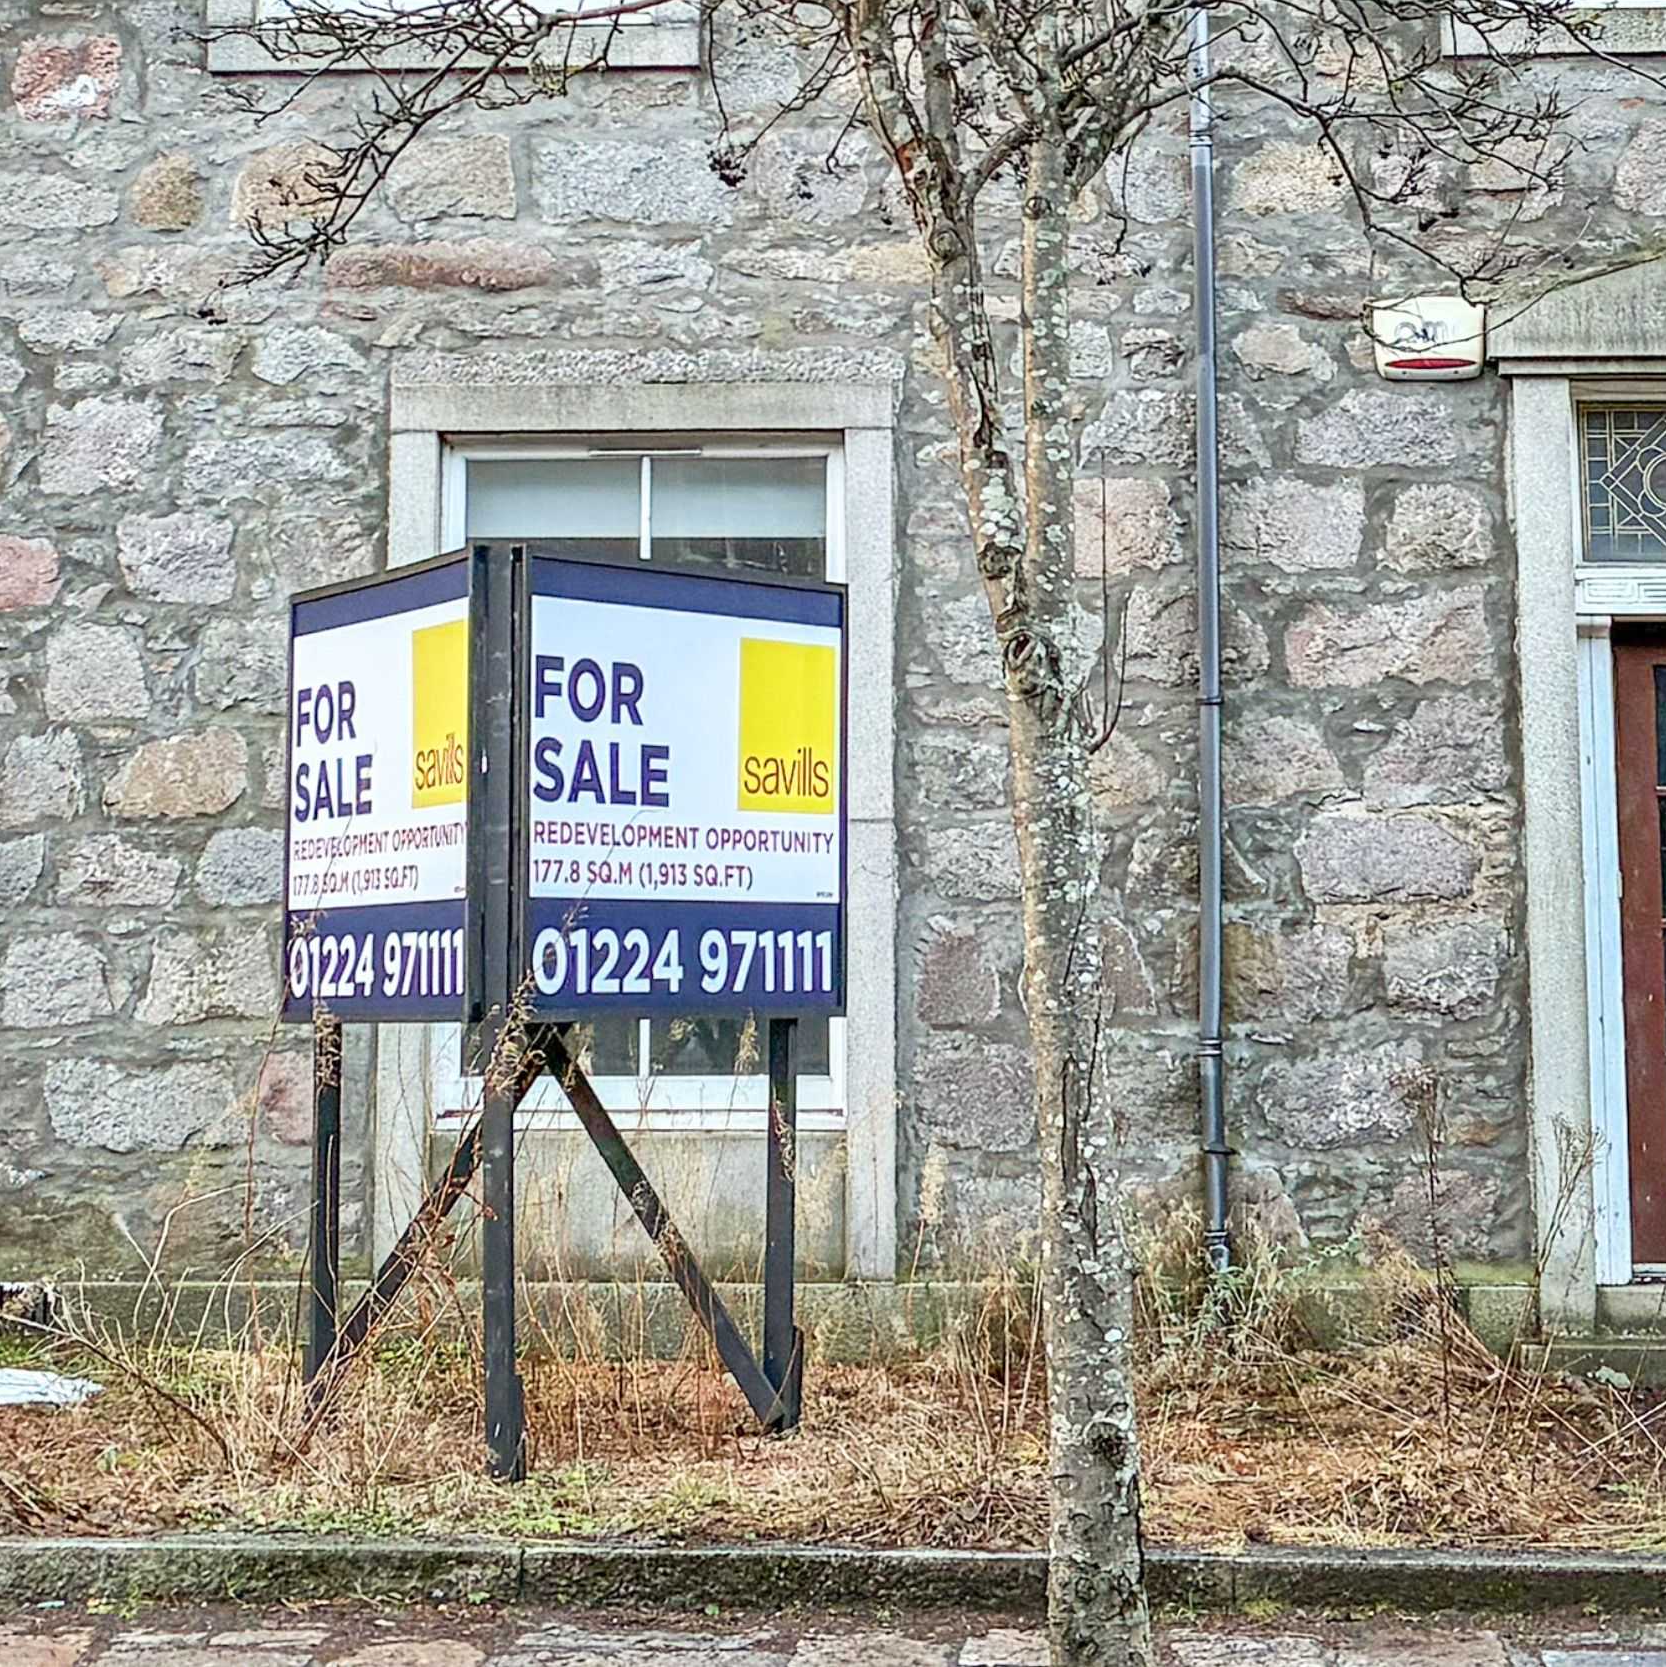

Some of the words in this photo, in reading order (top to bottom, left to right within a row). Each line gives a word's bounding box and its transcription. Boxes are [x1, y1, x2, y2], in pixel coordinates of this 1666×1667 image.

[296, 680, 357, 748] FOR
[535, 654, 644, 726] FOR
[294, 754, 373, 823] SALE
[415, 732, 464, 790] savills
[533, 737, 670, 808] SALE
[744, 747, 830, 798] savills
[293, 831, 390, 861] REDEVELOPMENT
[533, 820, 700, 850] REDEVELOPMENT
[706, 828, 834, 854] OPPORTUNITY
[293, 873, 318, 897] 177.8
[352, 867, 382, 896] (1,913
[384, 864, 419, 891] SQ.FT)
[533, 859, 581, 884] 177.8
[586, 860, 632, 885] SQ.M
[639, 862, 688, 891] (1,913
[693, 864, 753, 891] SQ.FT)
[289, 933, 375, 999] 01224
[382, 927, 465, 998] 971111
[532, 927, 684, 996] 01224
[699, 928, 833, 994] 971111
